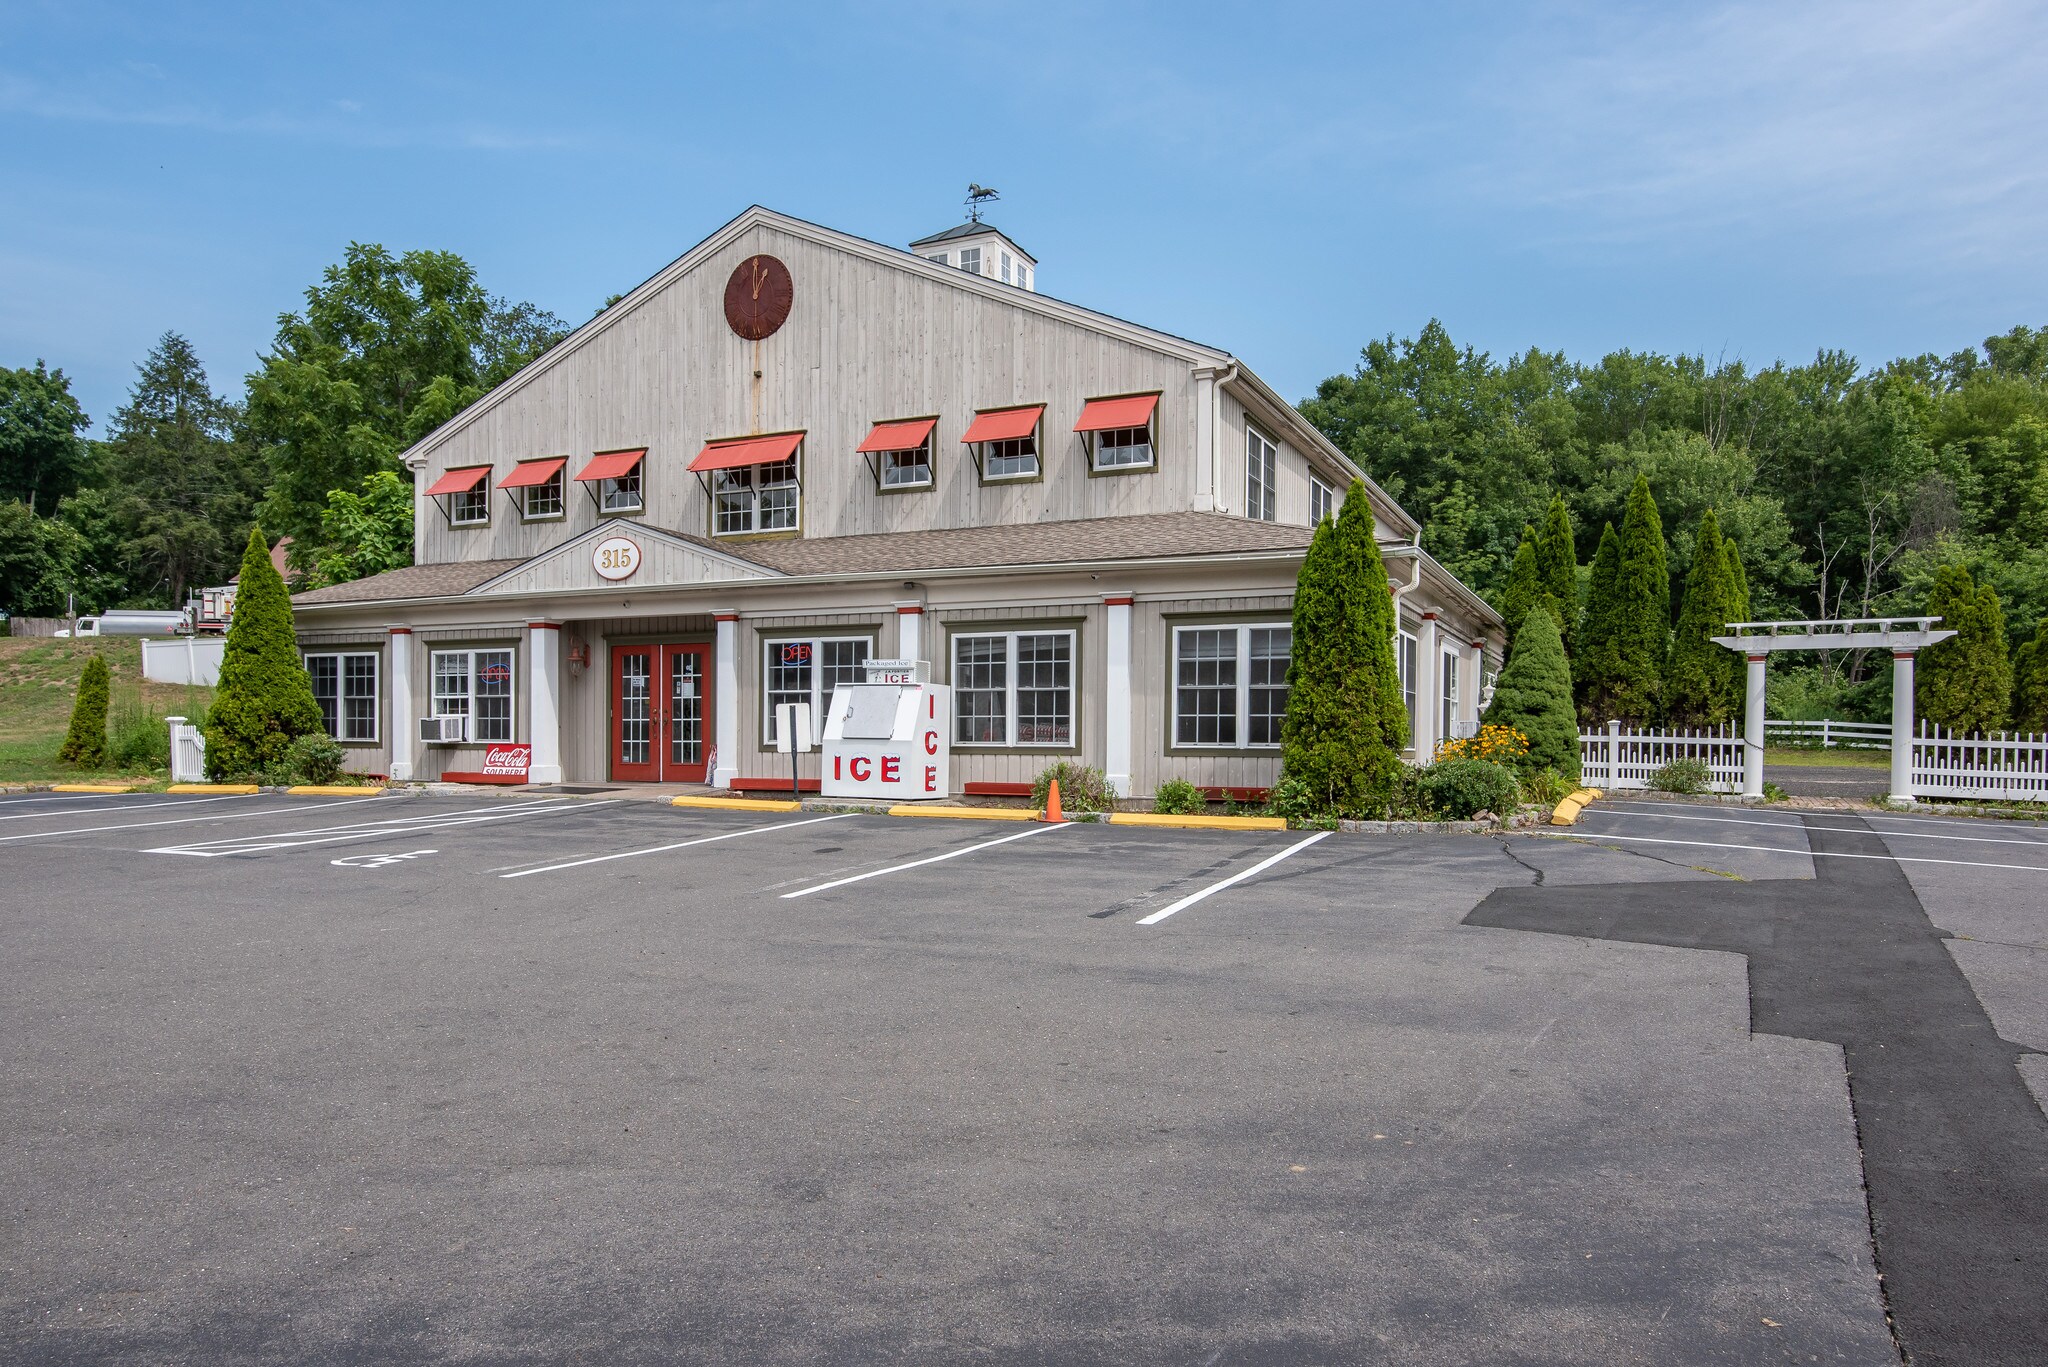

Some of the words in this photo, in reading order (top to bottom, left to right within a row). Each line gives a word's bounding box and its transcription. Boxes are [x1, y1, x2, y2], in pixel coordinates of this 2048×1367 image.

[601, 547, 631, 568] 315
[781, 645, 812, 660] OPEN
[885, 674, 909, 683] ICE
[924, 691, 938, 792] ICE
[505, 768, 524, 776] HERE
[834, 753, 901, 782] ICE
